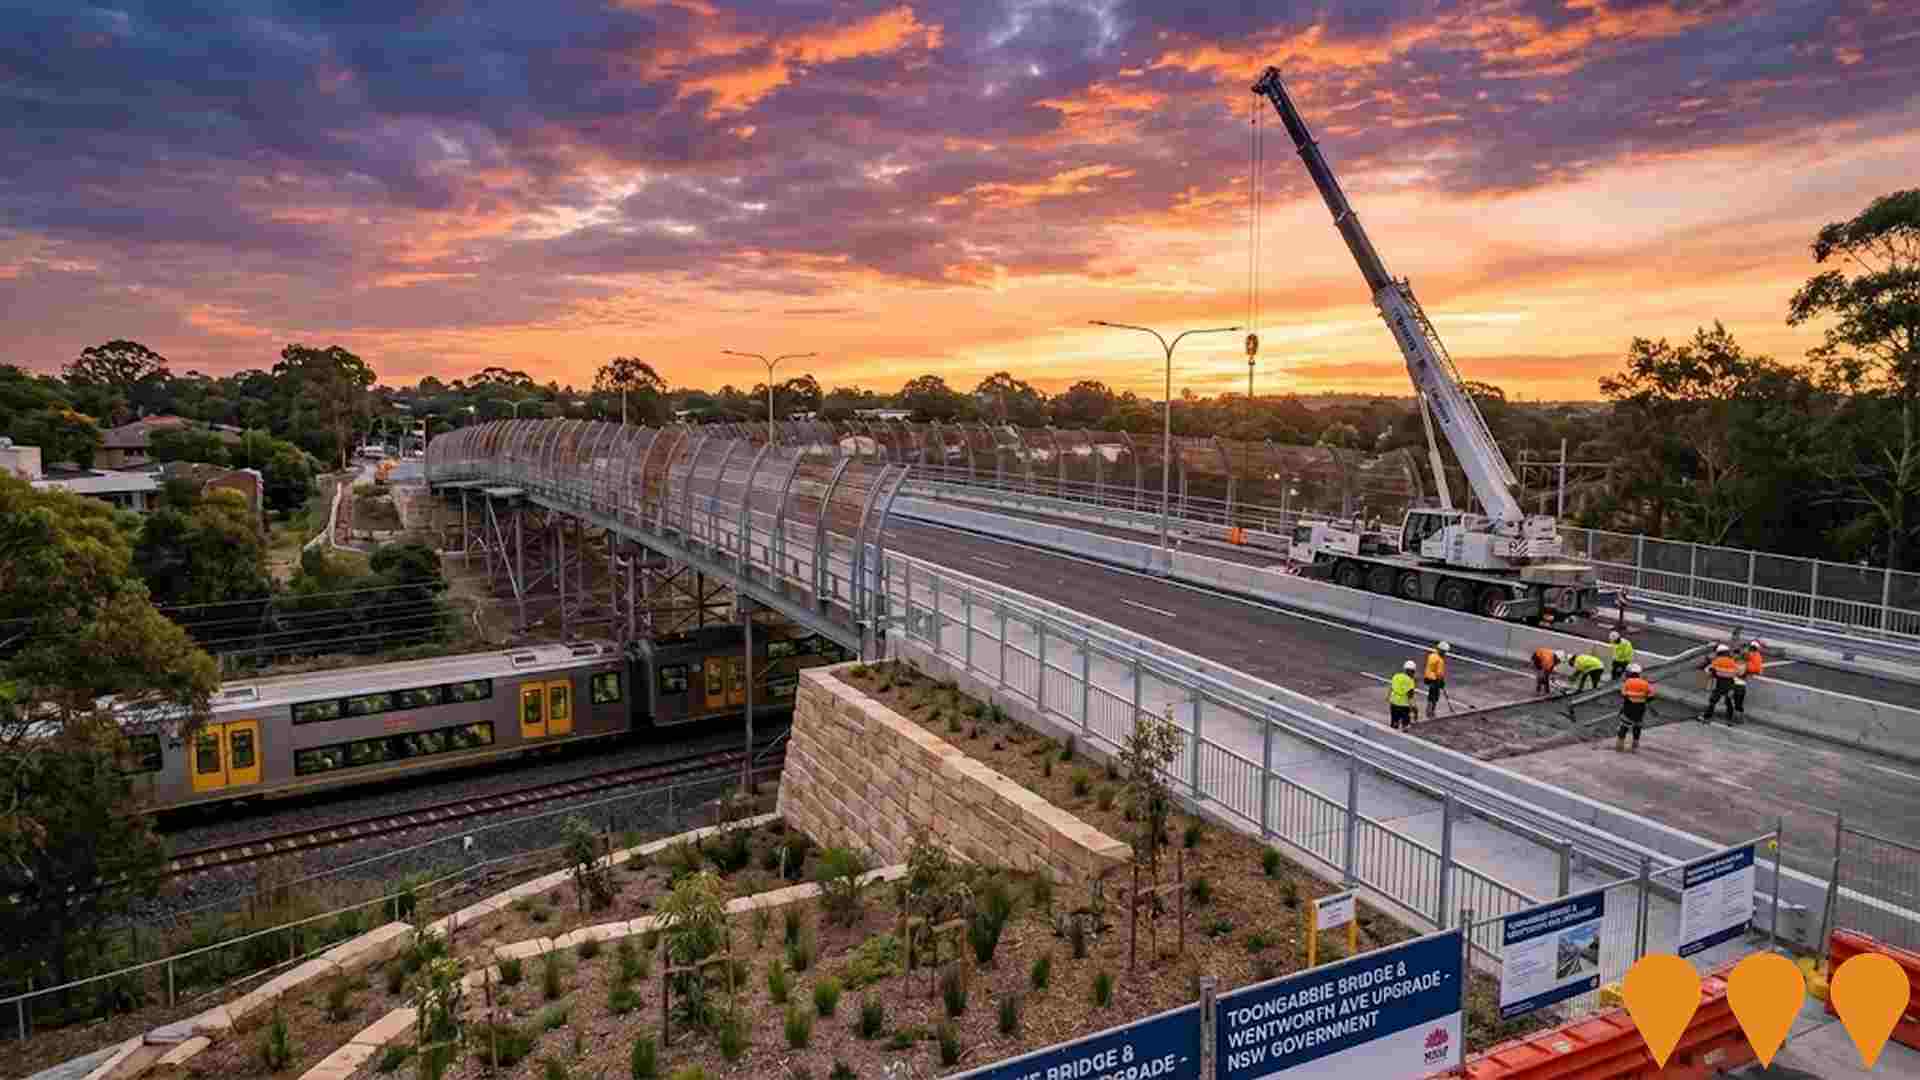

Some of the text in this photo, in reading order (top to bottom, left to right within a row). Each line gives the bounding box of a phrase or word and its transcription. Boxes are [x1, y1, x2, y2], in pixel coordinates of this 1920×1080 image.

[1227, 981, 1334, 1027] TOONGABBIE
[1338, 964, 1393, 995] BRIDGE
[1227, 1003, 1336, 1049] WENTWORTH
[1339, 992, 1369, 1016] AVE
[1372, 970, 1441, 1006] UPGRADE
[1047, 1049, 1118, 1080] BRIDGE
[1227, 1010, 1380, 1073] NSW GOVERNMENT
